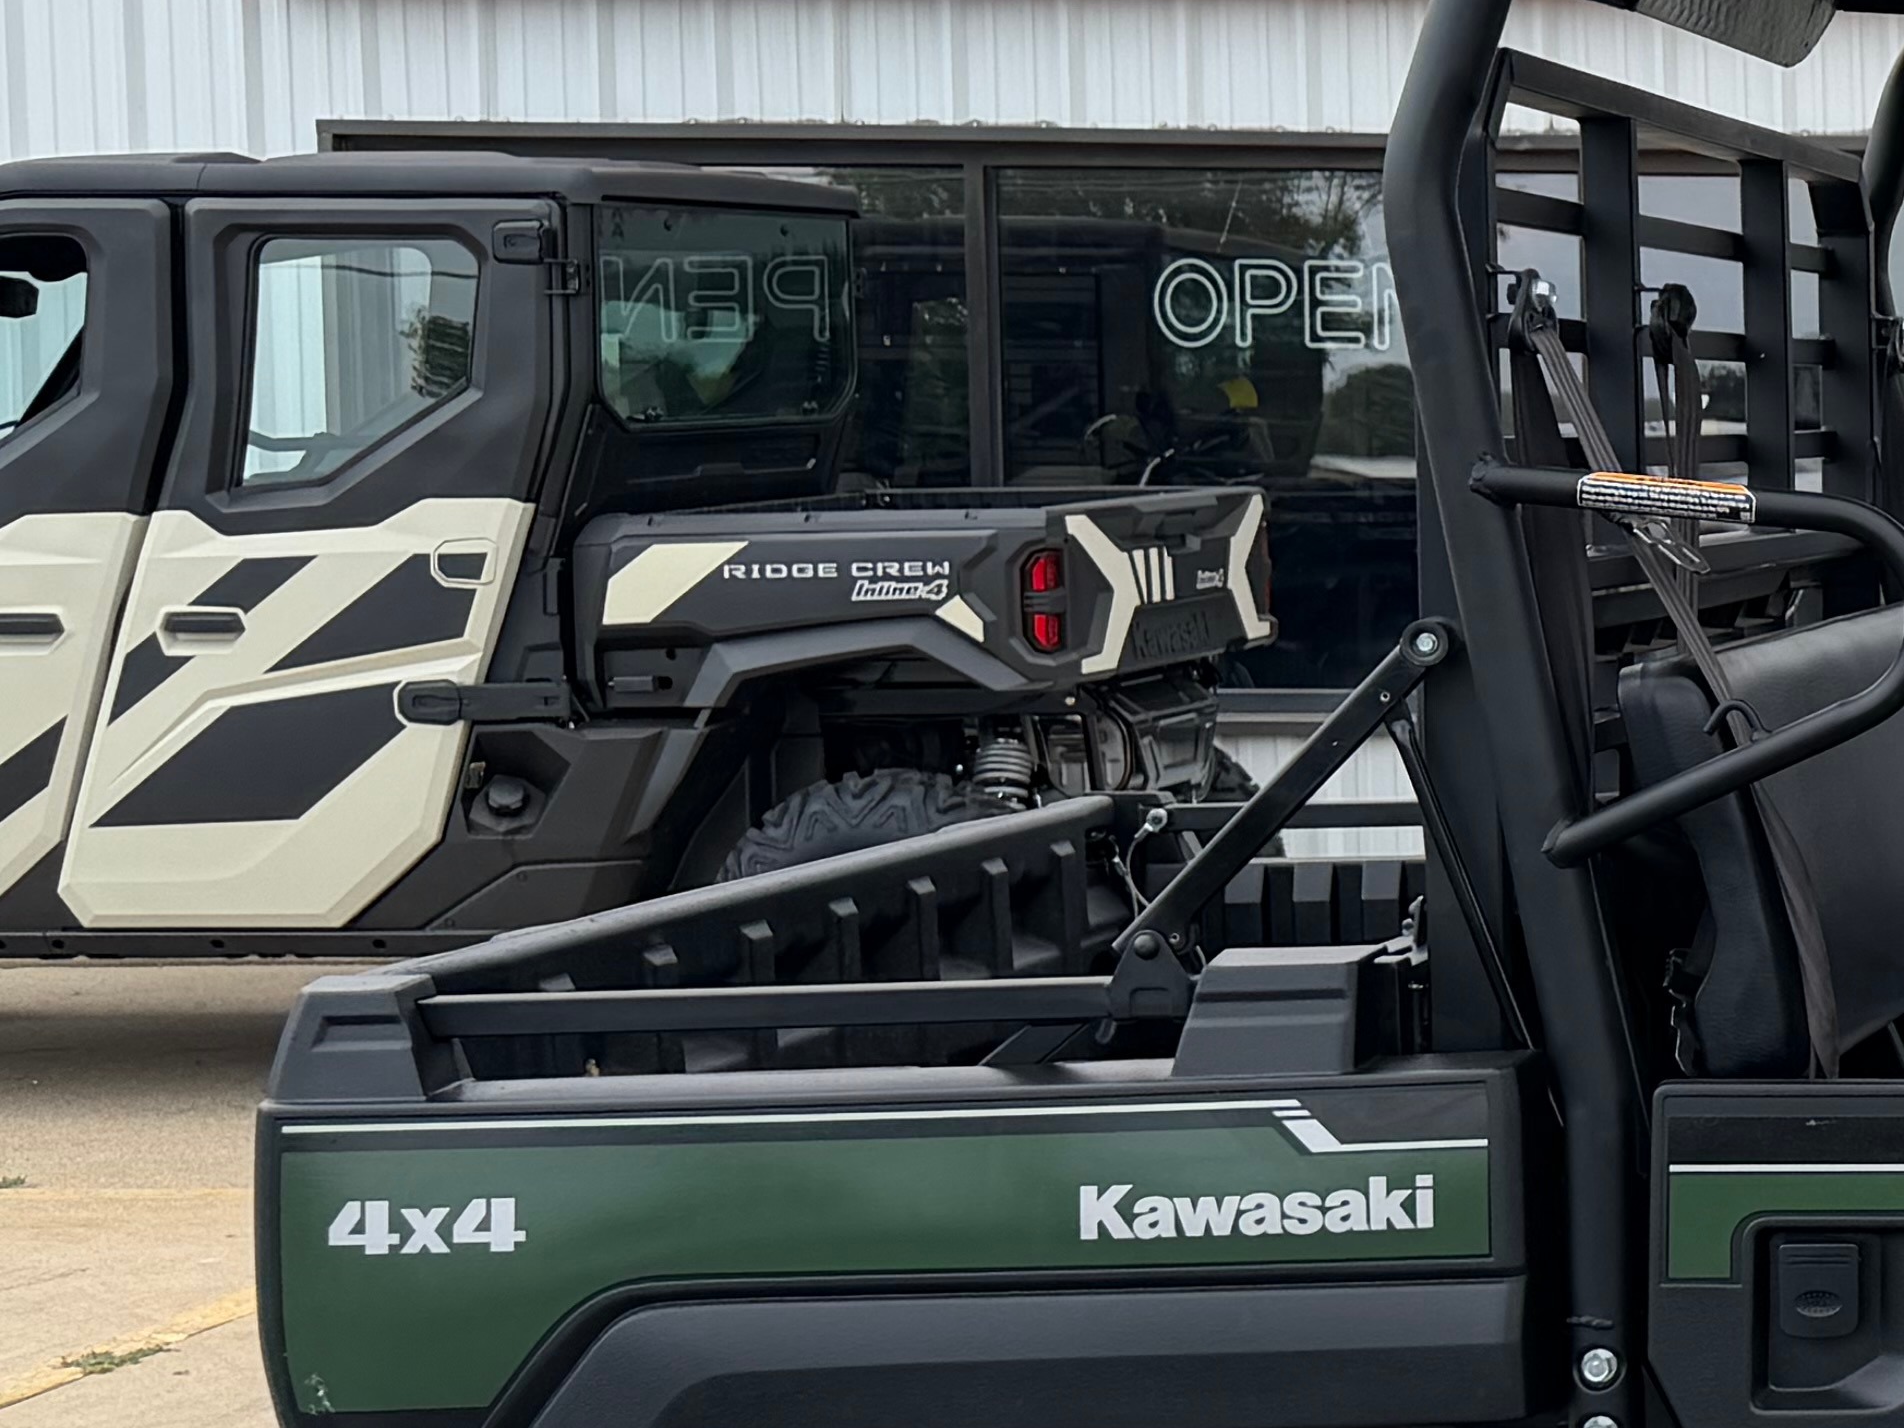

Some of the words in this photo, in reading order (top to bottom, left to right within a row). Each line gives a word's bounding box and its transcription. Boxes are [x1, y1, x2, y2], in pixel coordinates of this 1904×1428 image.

[723, 562, 838, 580] RIDGE
[850, 560, 950, 578] CREW
[328, 1197, 527, 1255] 4x4
[1079, 1174, 1434, 1240] Kawasaki
